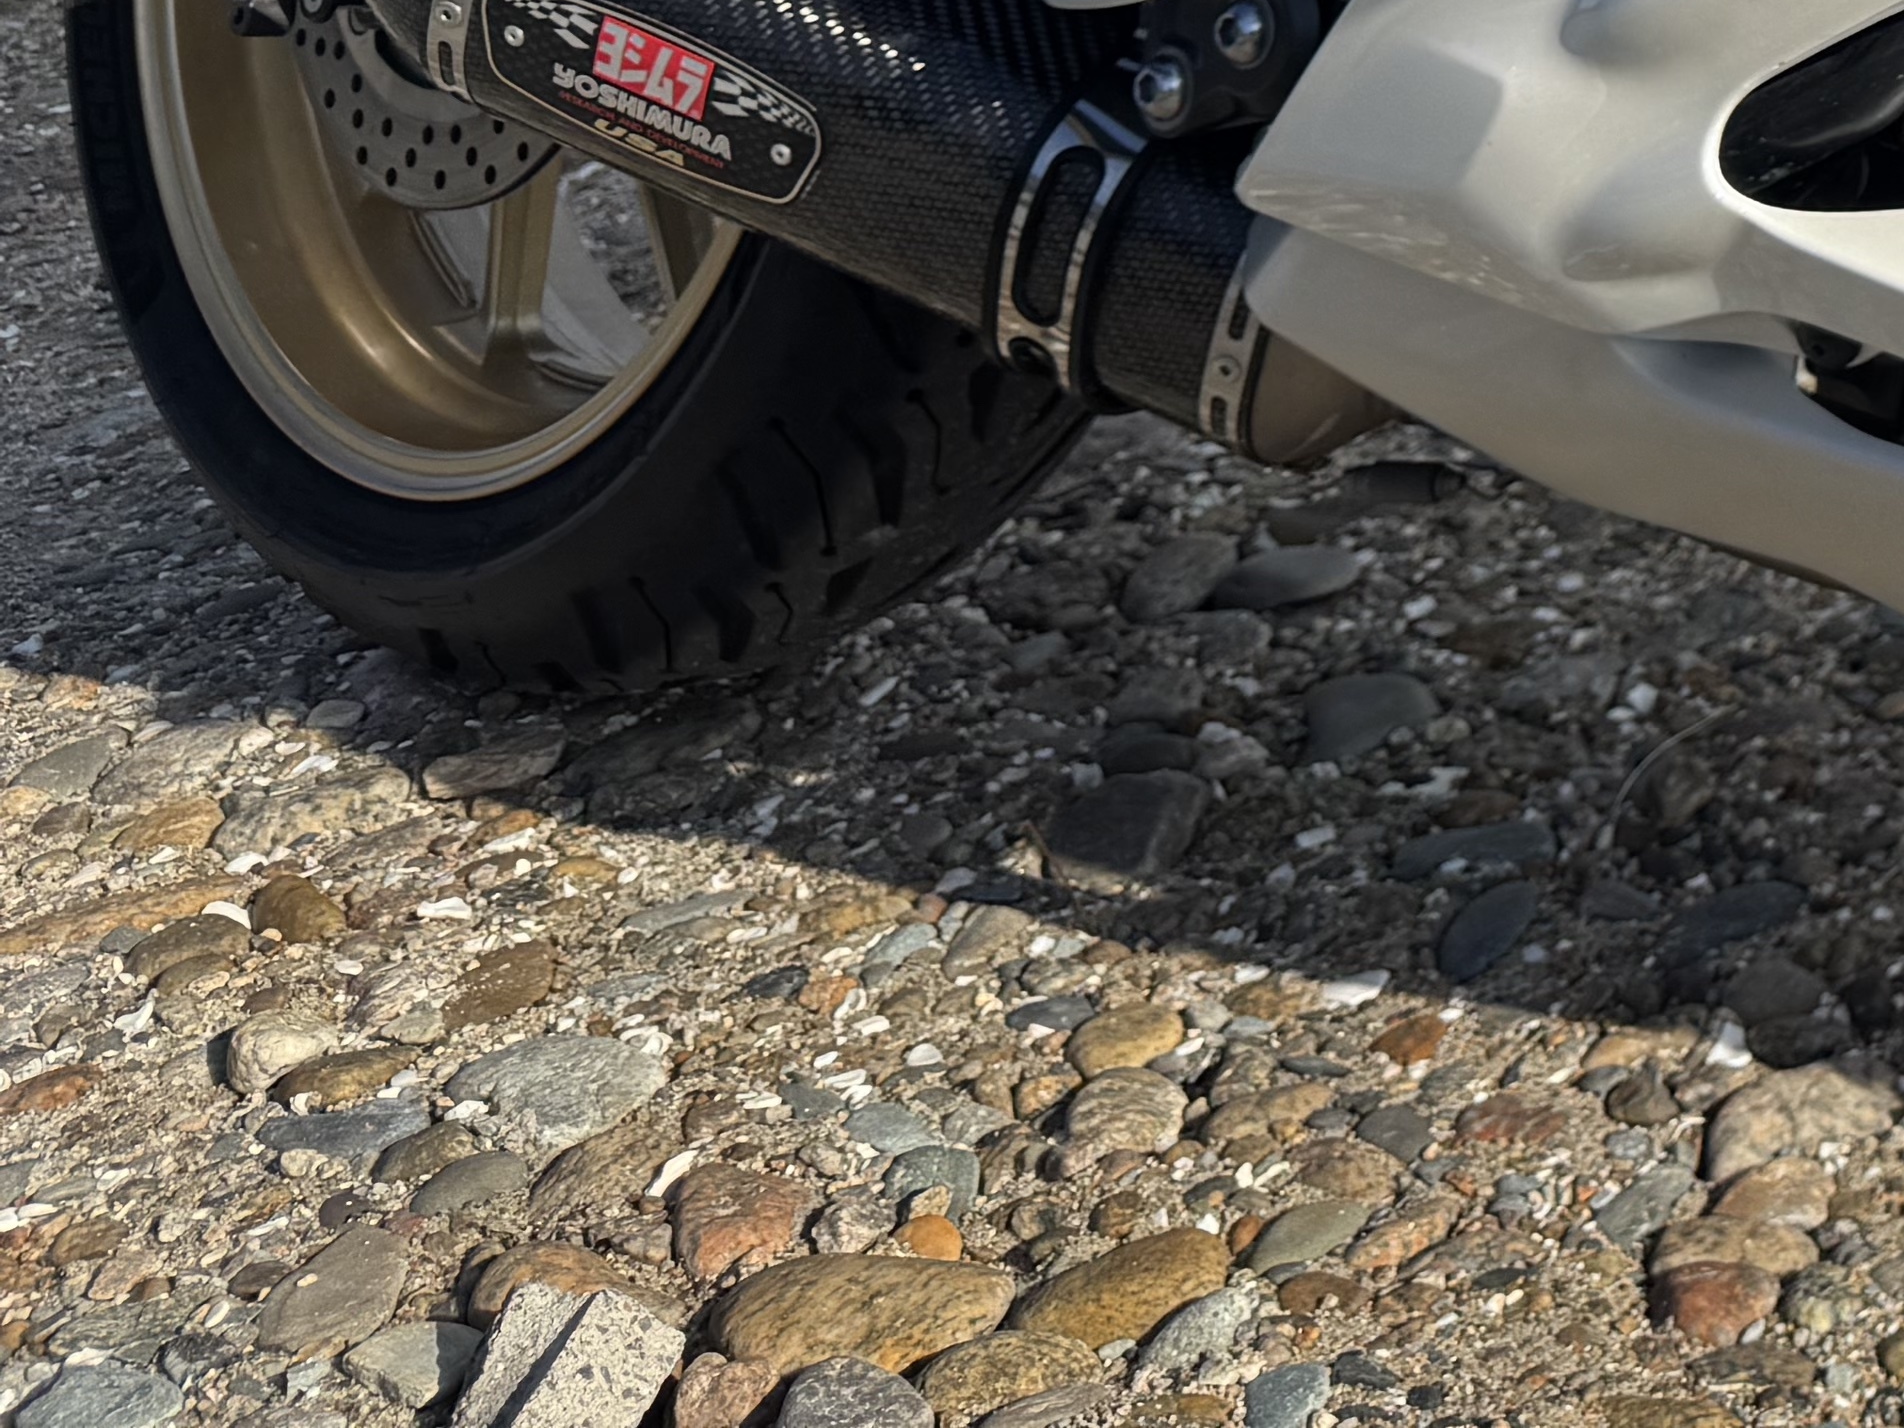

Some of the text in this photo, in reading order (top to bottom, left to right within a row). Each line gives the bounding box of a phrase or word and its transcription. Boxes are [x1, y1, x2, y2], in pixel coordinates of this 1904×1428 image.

[553, 62, 731, 160] YOSHIMURA
[598, 24, 709, 114] ヨシムラ
[594, 118, 684, 166] USA
